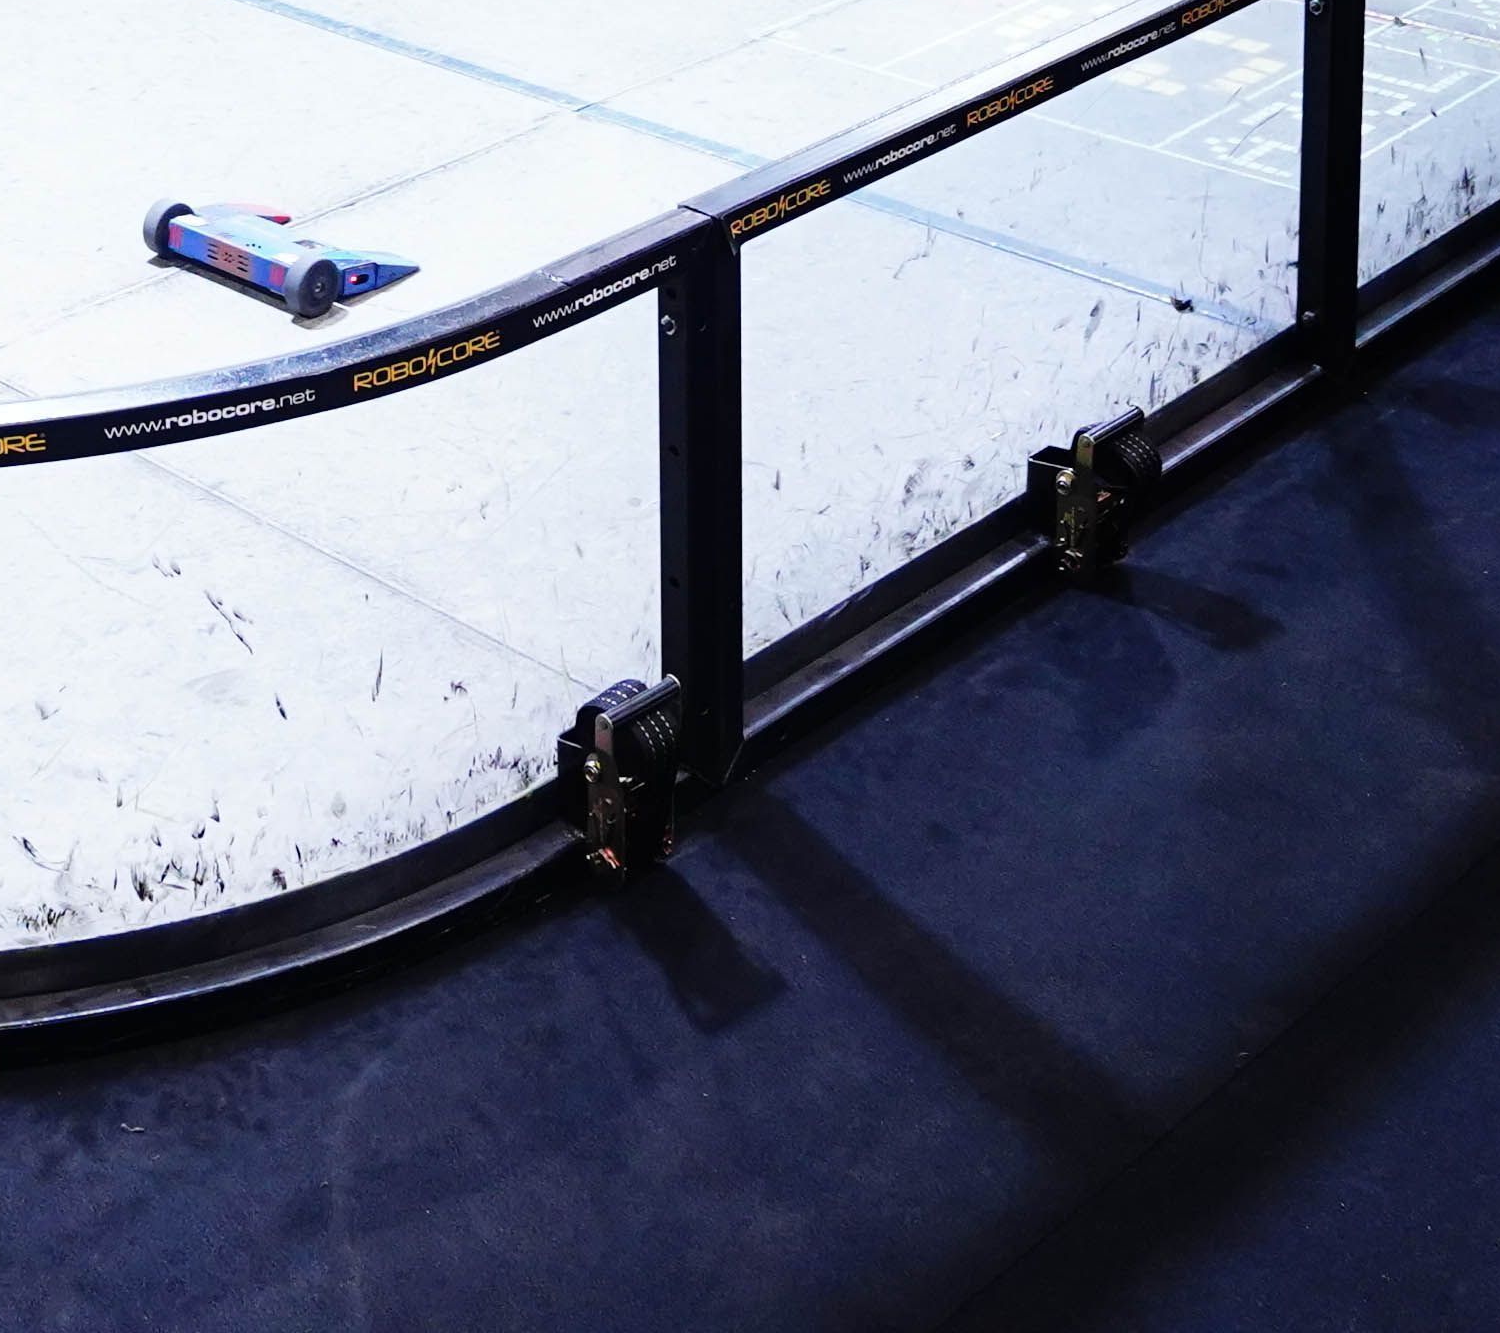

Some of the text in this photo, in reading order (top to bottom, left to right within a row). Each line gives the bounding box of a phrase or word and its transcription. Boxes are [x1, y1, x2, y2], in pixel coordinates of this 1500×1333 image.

[1080, 21, 1177, 73] www.robocore.net
[843, 124, 957, 184] www.robocore.net
[533, 254, 678, 329] www.robocore.net
[105, 388, 317, 440] www.robocore.net
